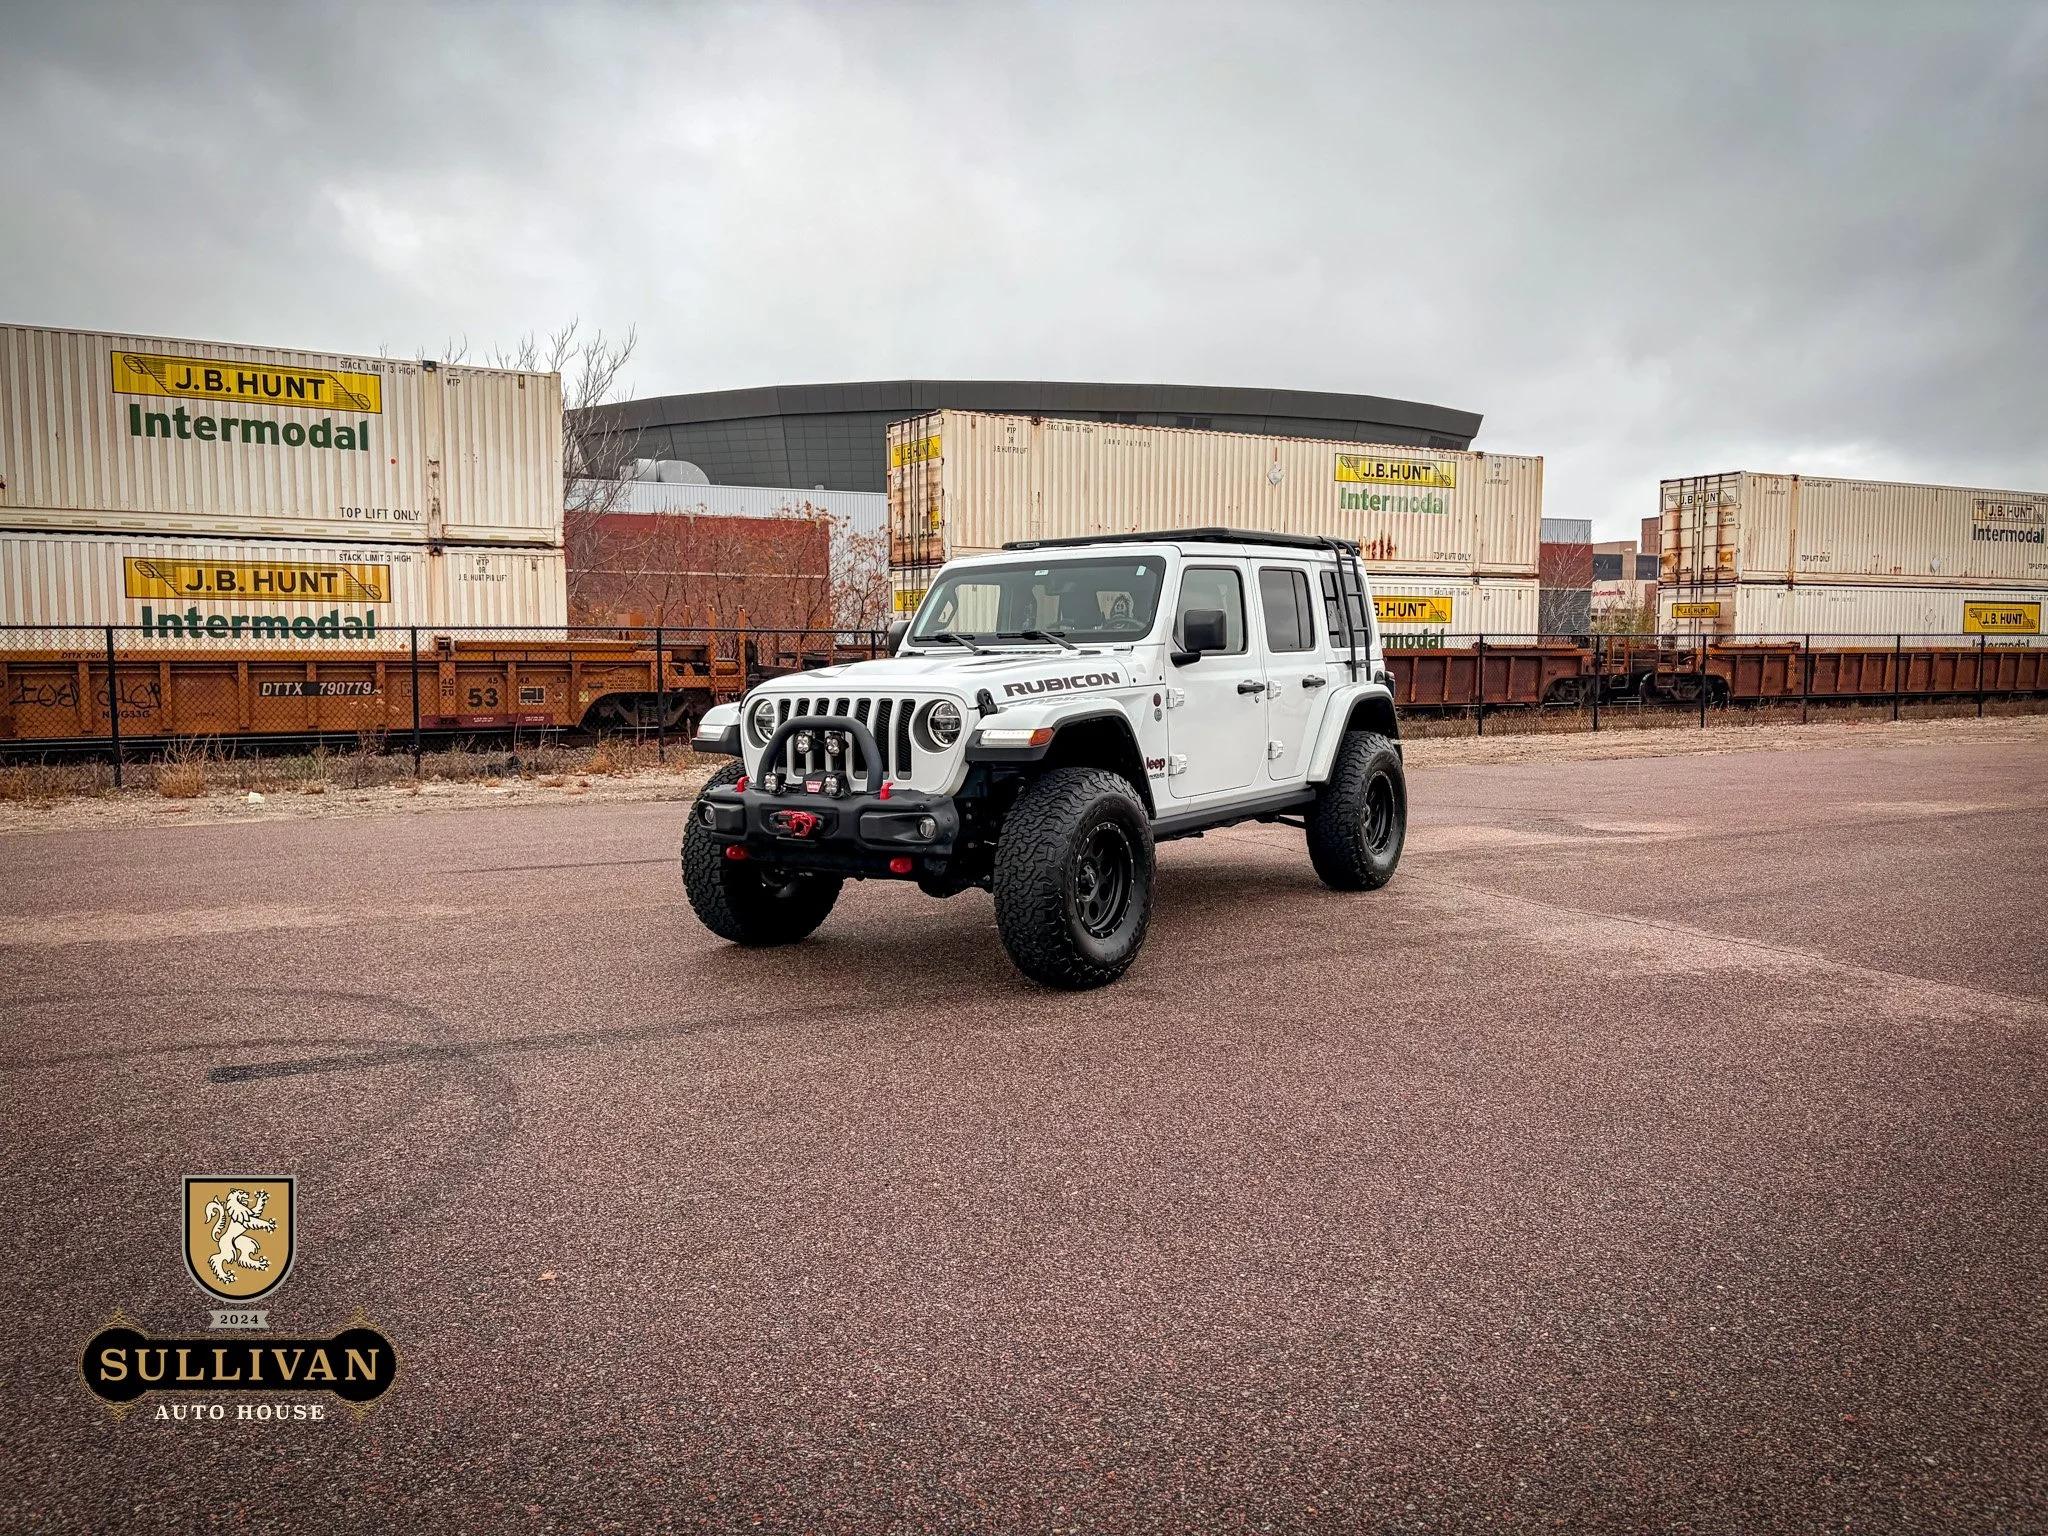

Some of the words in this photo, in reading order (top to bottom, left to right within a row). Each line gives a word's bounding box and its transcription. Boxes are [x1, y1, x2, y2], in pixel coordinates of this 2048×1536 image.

[340, 360, 362, 371] STACK
[366, 363, 385, 373] LIMIT
[389, 366, 395, 374] 3
[399, 366, 416, 377] HIGH
[175, 367, 232, 393] J.B.
[237, 371, 325, 400] HUNT
[129, 403, 369, 452] Intermodal
[1362, 463, 1388, 478] J.B.
[1390, 466, 1431, 480] HUNT
[1340, 487, 1449, 514] Intermodal
[339, 507, 362, 518] TOP
[365, 508, 389, 520] LIFT
[393, 509, 420, 521] ONLY
[1973, 523, 2045, 544] Intermodal
[339, 553, 362, 562] STACK
[365, 554, 384, 562] LIMIT
[386, 554, 391, 562] 3
[394, 555, 412, 563] HIGH
[185, 569, 246, 592] J.B.
[253, 570, 338, 593] HUNT
[1386, 602, 1427, 617] HUNT
[2000, 613, 2023, 625] HUNT
[142, 605, 376, 639] Intermodal
[262, 682, 303, 696] DTTX
[318, 681, 373, 696] 790779
[1002, 671, 1120, 697] RUBICON
[467, 687, 499, 708] 53
